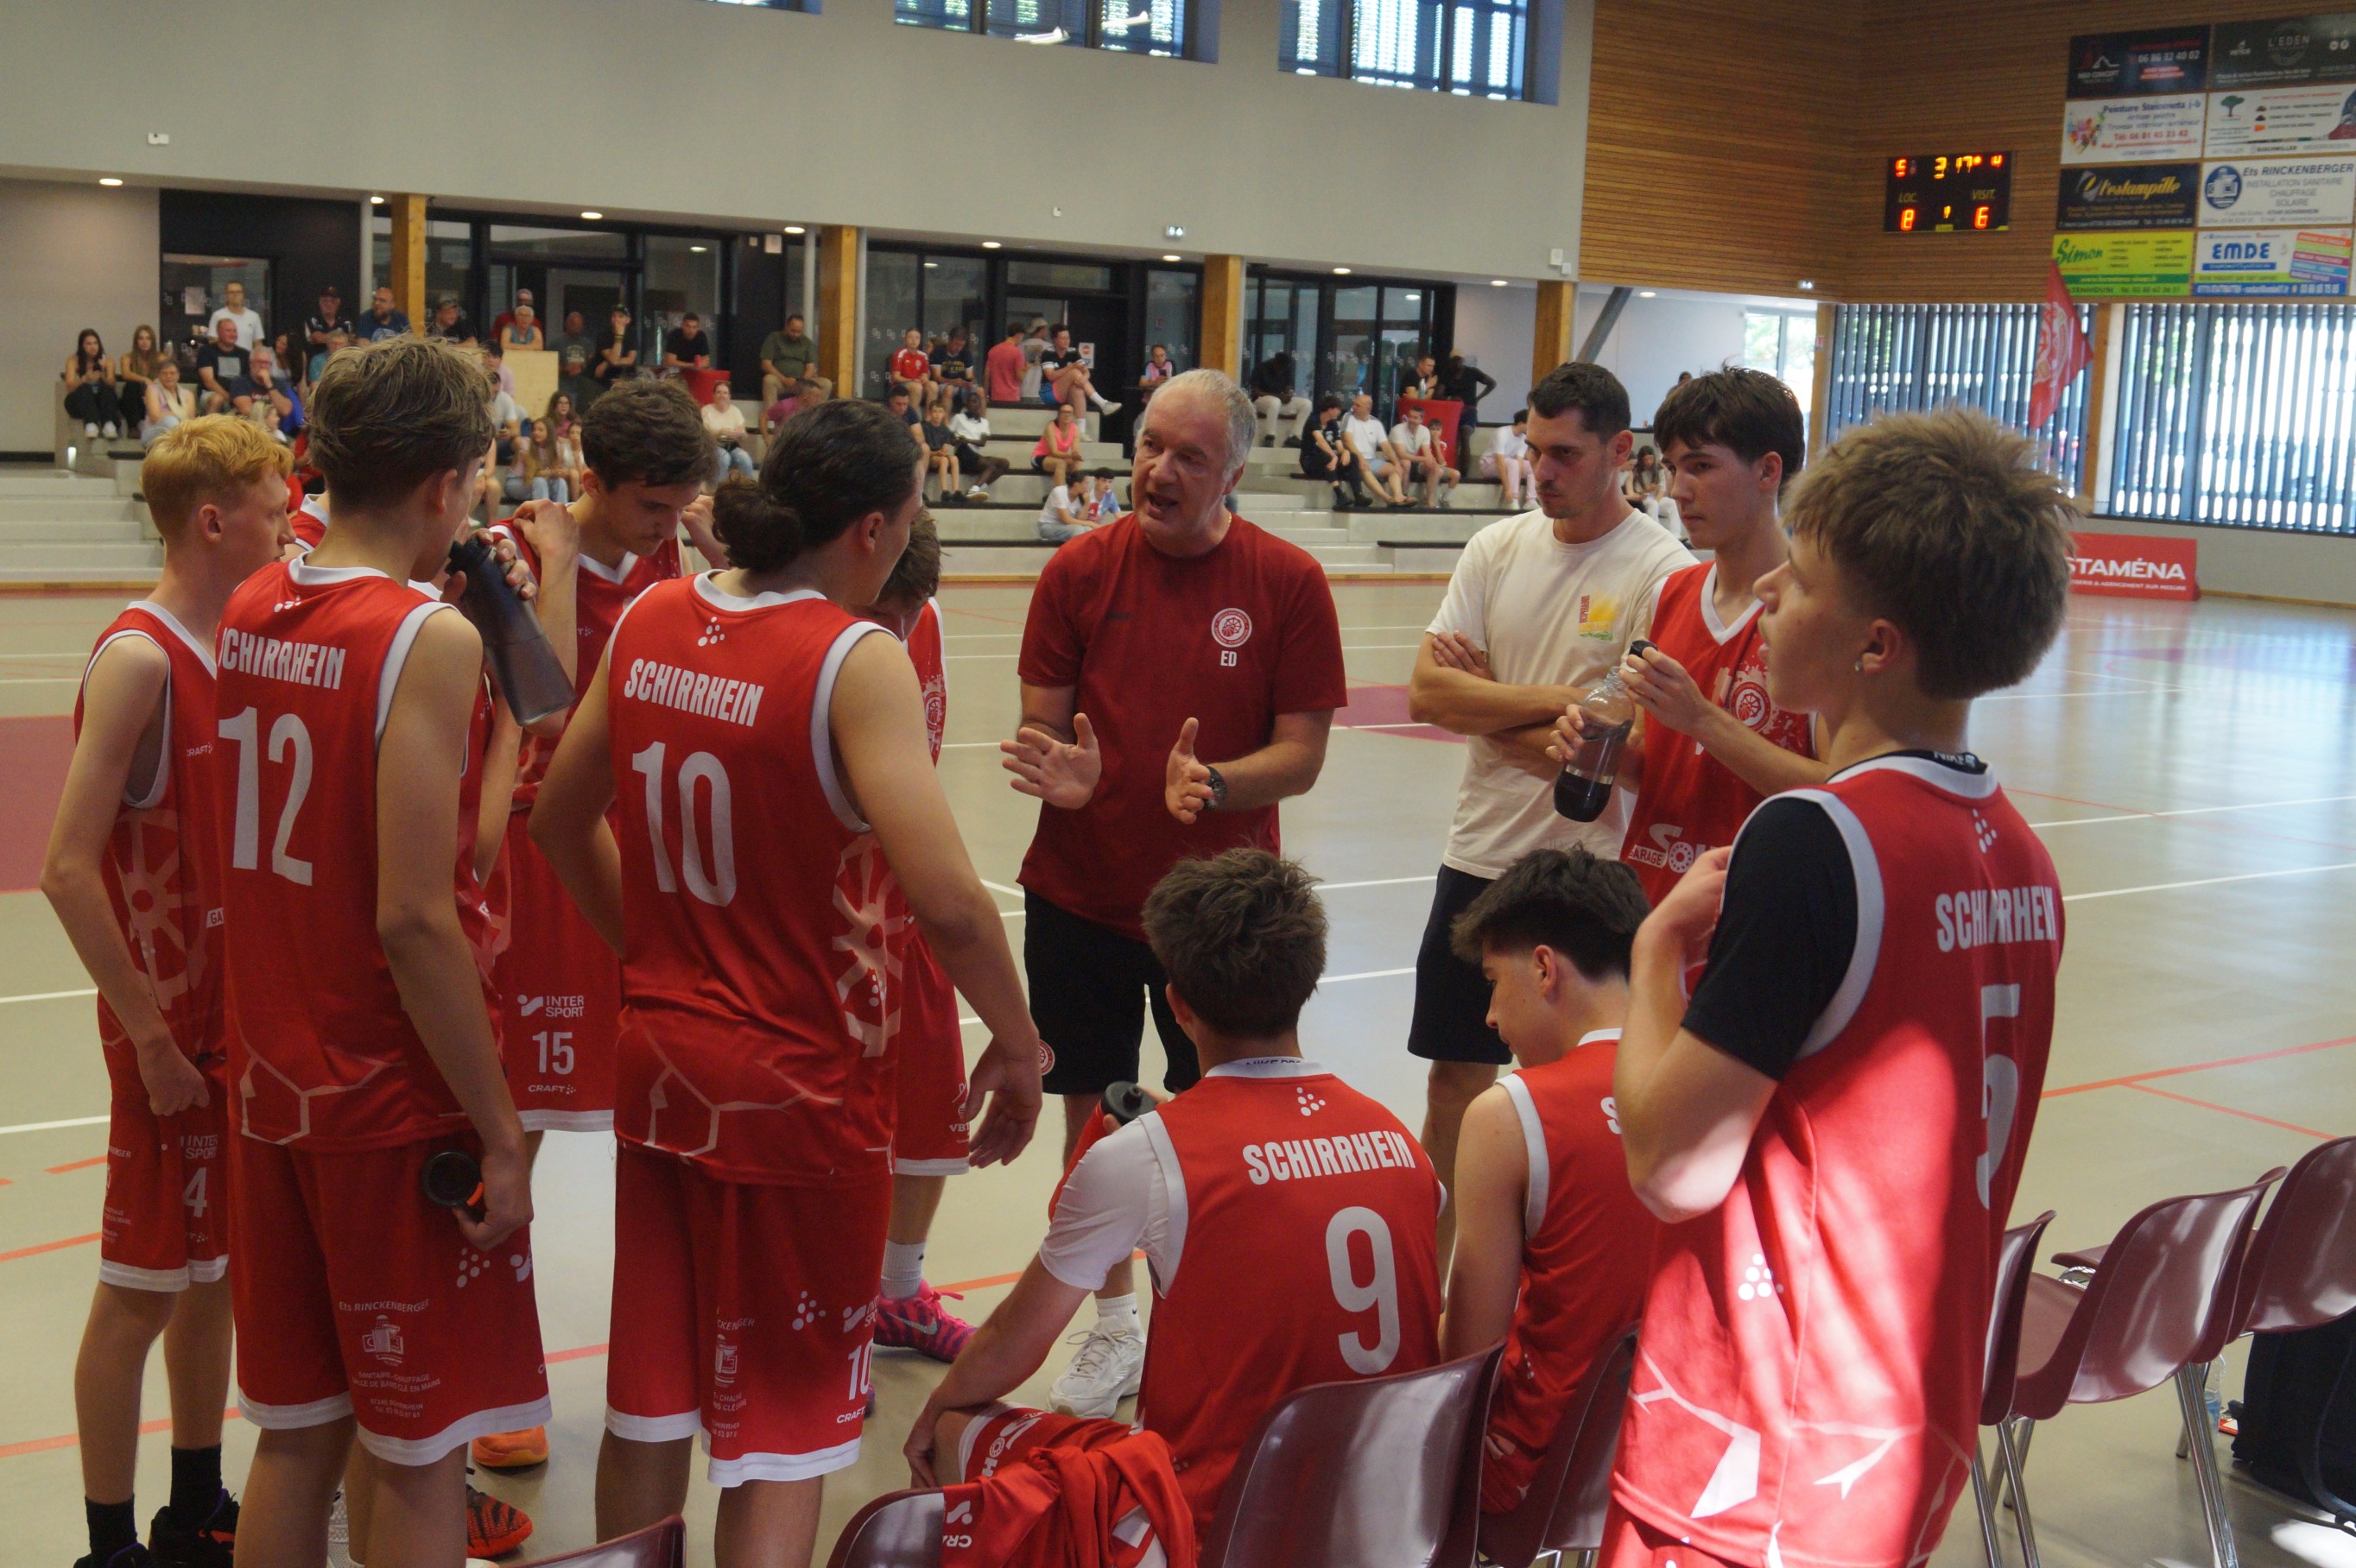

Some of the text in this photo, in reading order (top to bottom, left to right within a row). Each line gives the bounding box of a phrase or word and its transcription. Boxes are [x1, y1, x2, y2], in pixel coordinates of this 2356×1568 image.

[2103, 104, 2139, 114] Peinture
[2243, 163, 2354, 176] Ets RINCKENBERGER
[2246, 177, 2343, 187] INSTALLATION SANITAIRE
[2270, 188, 2317, 197] CHAUFFAGE
[1974, 205, 1990, 229] 6
[2056, 237, 2104, 265] Simon
[2212, 242, 2270, 259] EMDE
[1220, 650, 1237, 667] ED
[624, 658, 764, 726] SCHIRRHEIN
[218, 705, 313, 886] 12
[632, 741, 737, 907] 10
[546, 996, 584, 1006] INTER
[546, 1006, 584, 1017] SPORT
[532, 1031, 574, 1075] 15
[1976, 983, 2020, 1210] 5
[1242, 1130, 1416, 1185] SCHIRRHEIN
[183, 1167, 207, 1217] 4
[1326, 1206, 1400, 1375] 9
[339, 1299, 429, 1312] Ets RINCKENBERGER
[848, 1337, 874, 1400] 10
[836, 1406, 865, 1424] CRAFT
